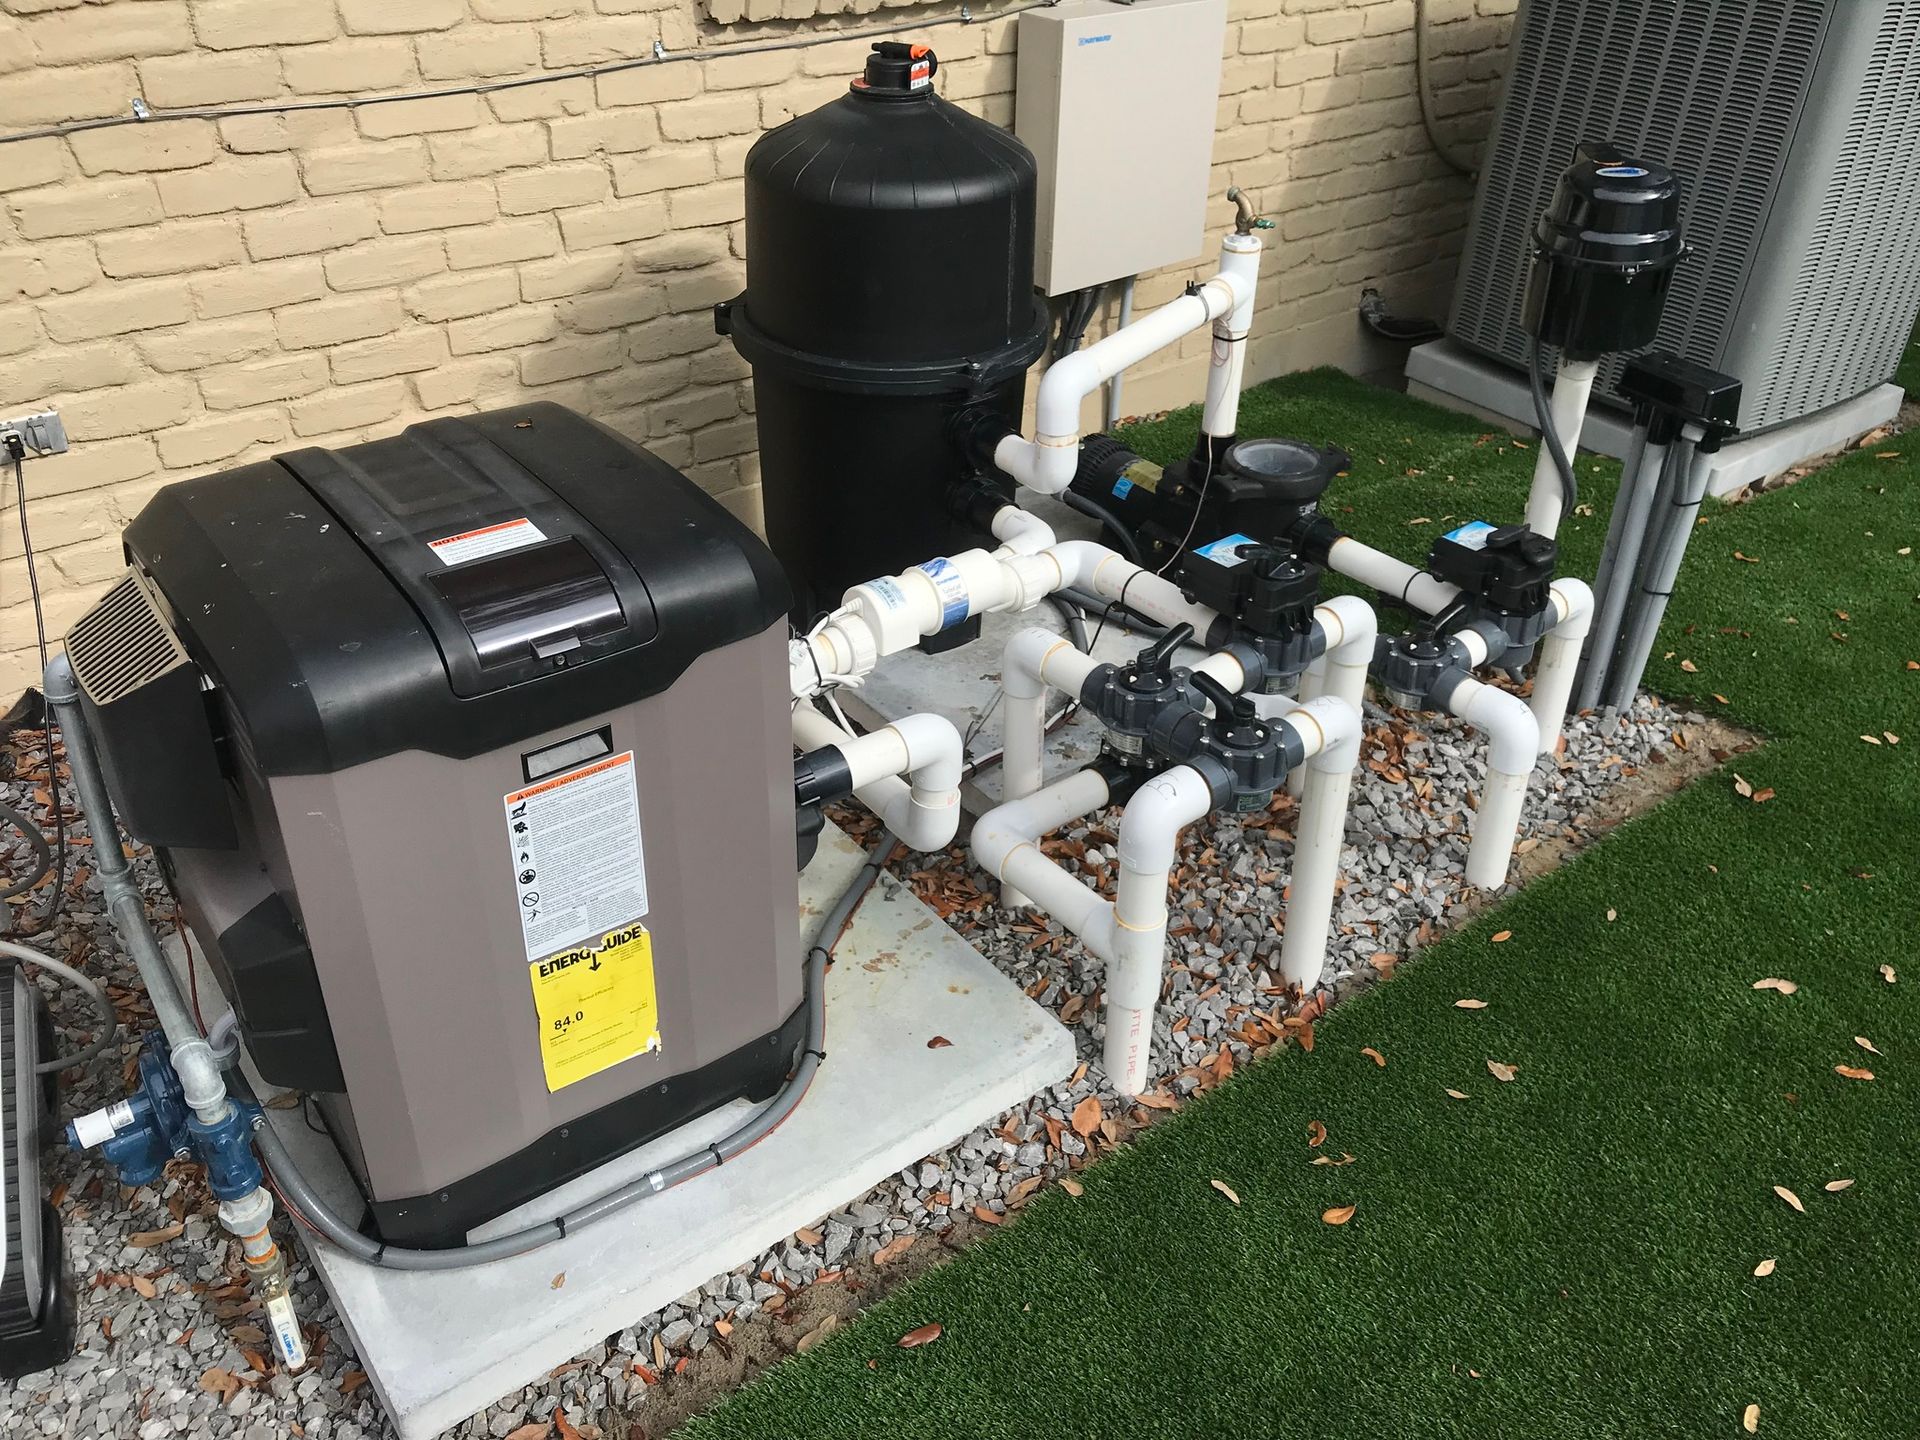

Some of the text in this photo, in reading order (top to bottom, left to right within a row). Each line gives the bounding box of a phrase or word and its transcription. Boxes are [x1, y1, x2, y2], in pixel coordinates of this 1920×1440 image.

[525, 782, 556, 798] WARNING
[560, 761, 615, 785] ADVERTISSEMENT
[539, 926, 642, 977] ENERGUIDE
[554, 1011, 584, 1029] 84.0
